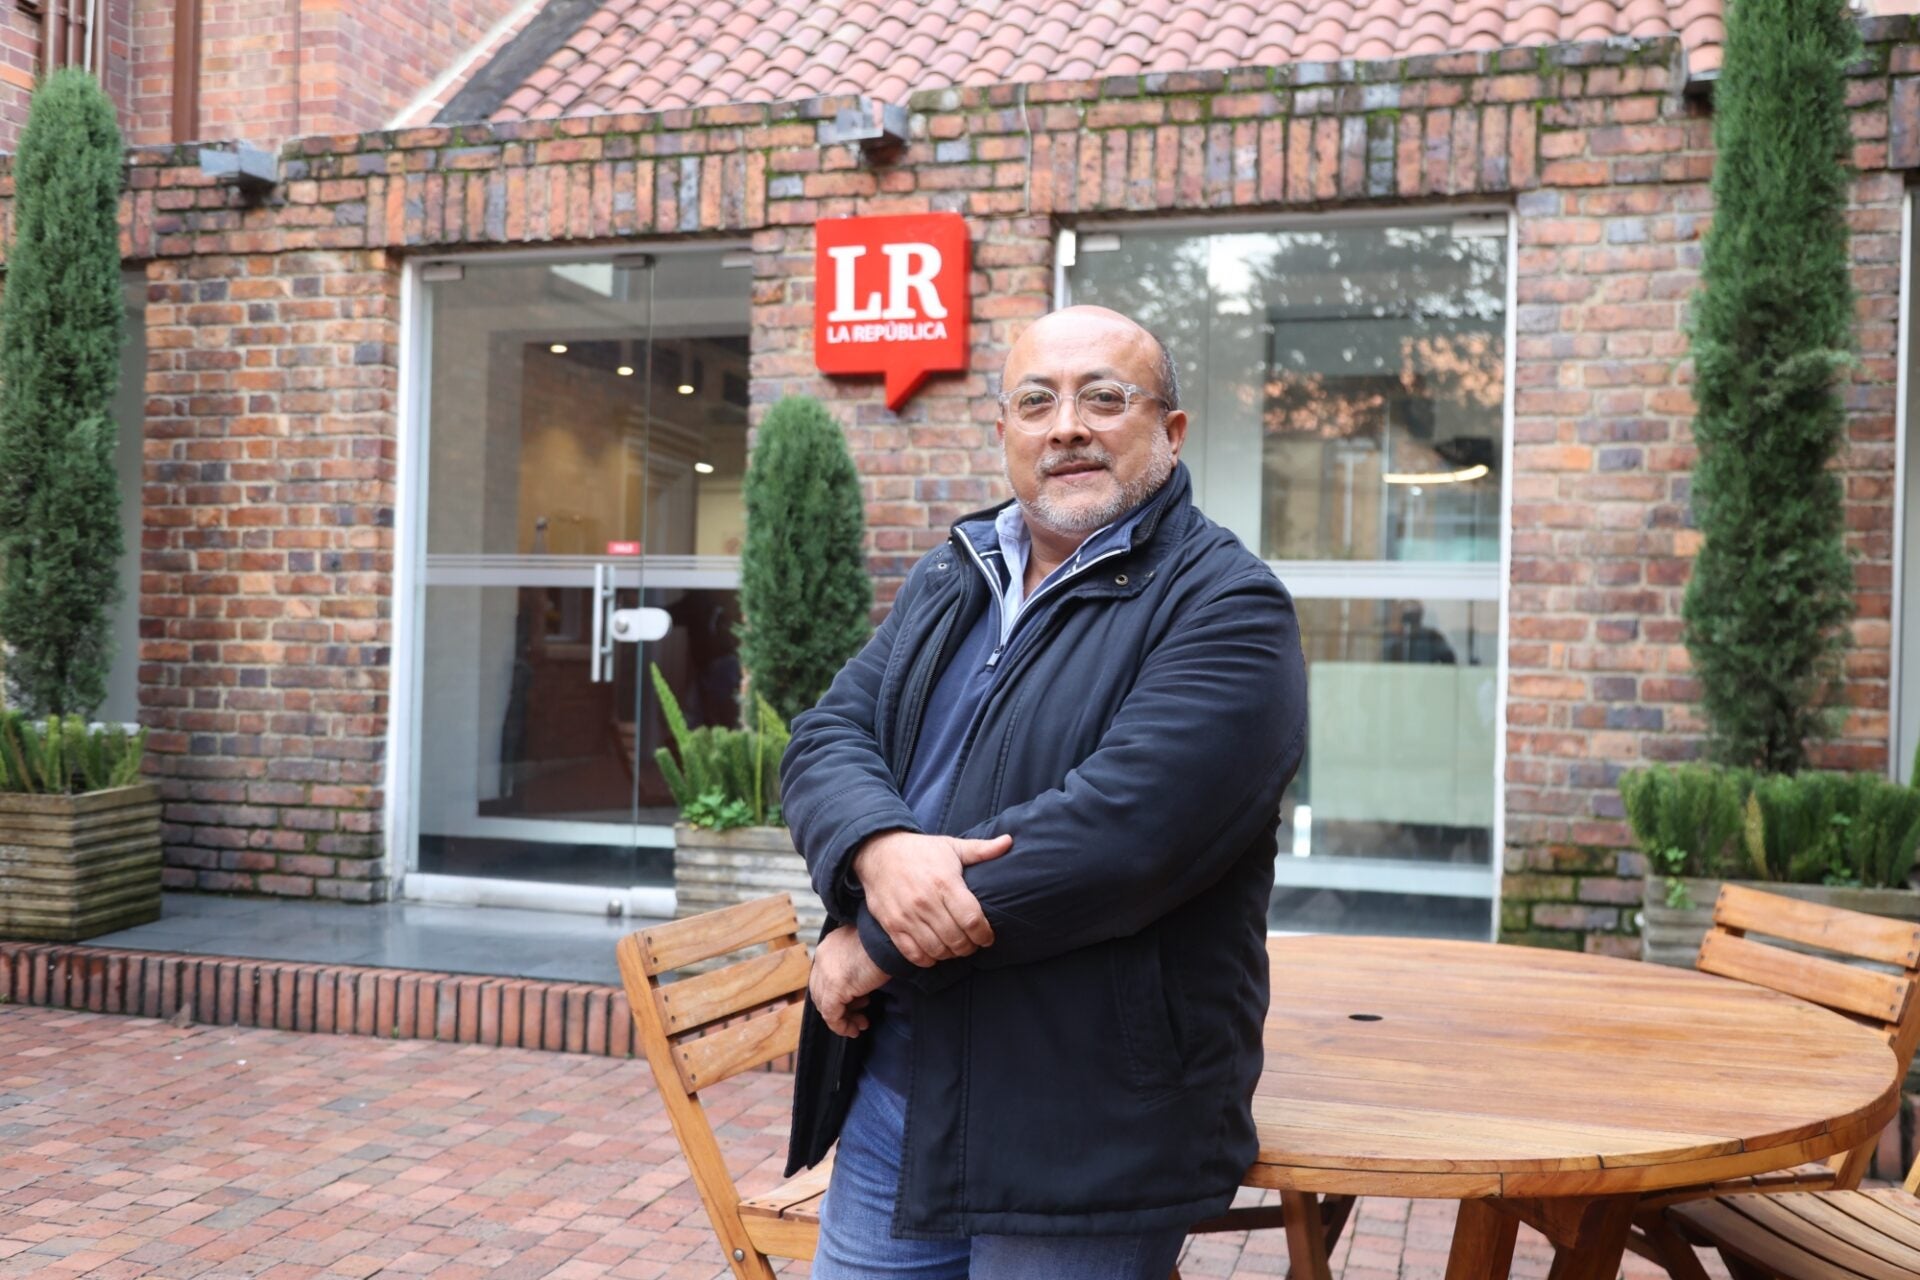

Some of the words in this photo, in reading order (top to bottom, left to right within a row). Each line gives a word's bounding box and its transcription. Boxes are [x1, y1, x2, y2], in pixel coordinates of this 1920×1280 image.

[827, 242, 948, 322] LR
[826, 325, 850, 344] LA
[852, 320, 947, 343] REPÚBLICA
